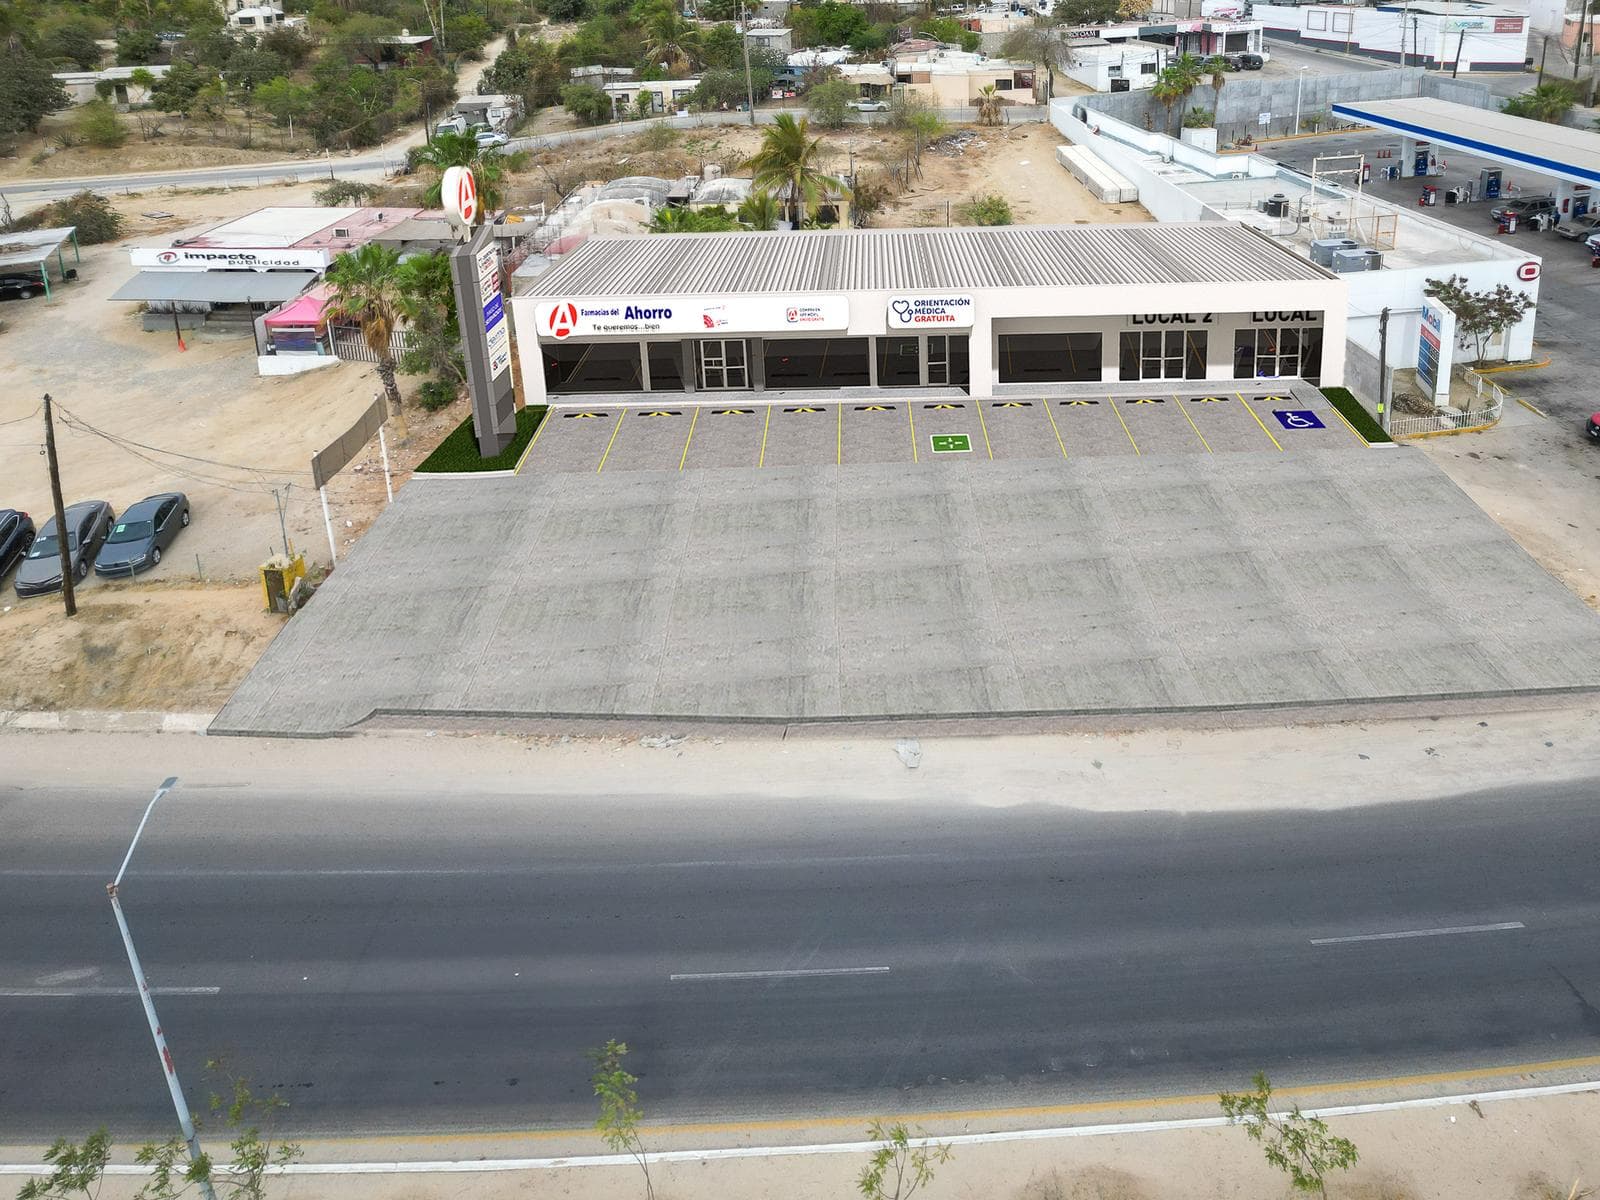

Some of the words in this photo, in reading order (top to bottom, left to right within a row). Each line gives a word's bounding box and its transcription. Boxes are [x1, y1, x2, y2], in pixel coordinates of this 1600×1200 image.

[184, 251, 257, 260] impacto
[914, 298, 970, 307] ORIENTACIÓN
[581, 308, 609, 316] Farmacias
[610, 308, 619, 316] del
[624, 306, 672, 320] Ahorro
[914, 307, 946, 315] MÉDICA
[549, 302, 578, 337] A
[914, 315, 955, 323] GRATUITA
